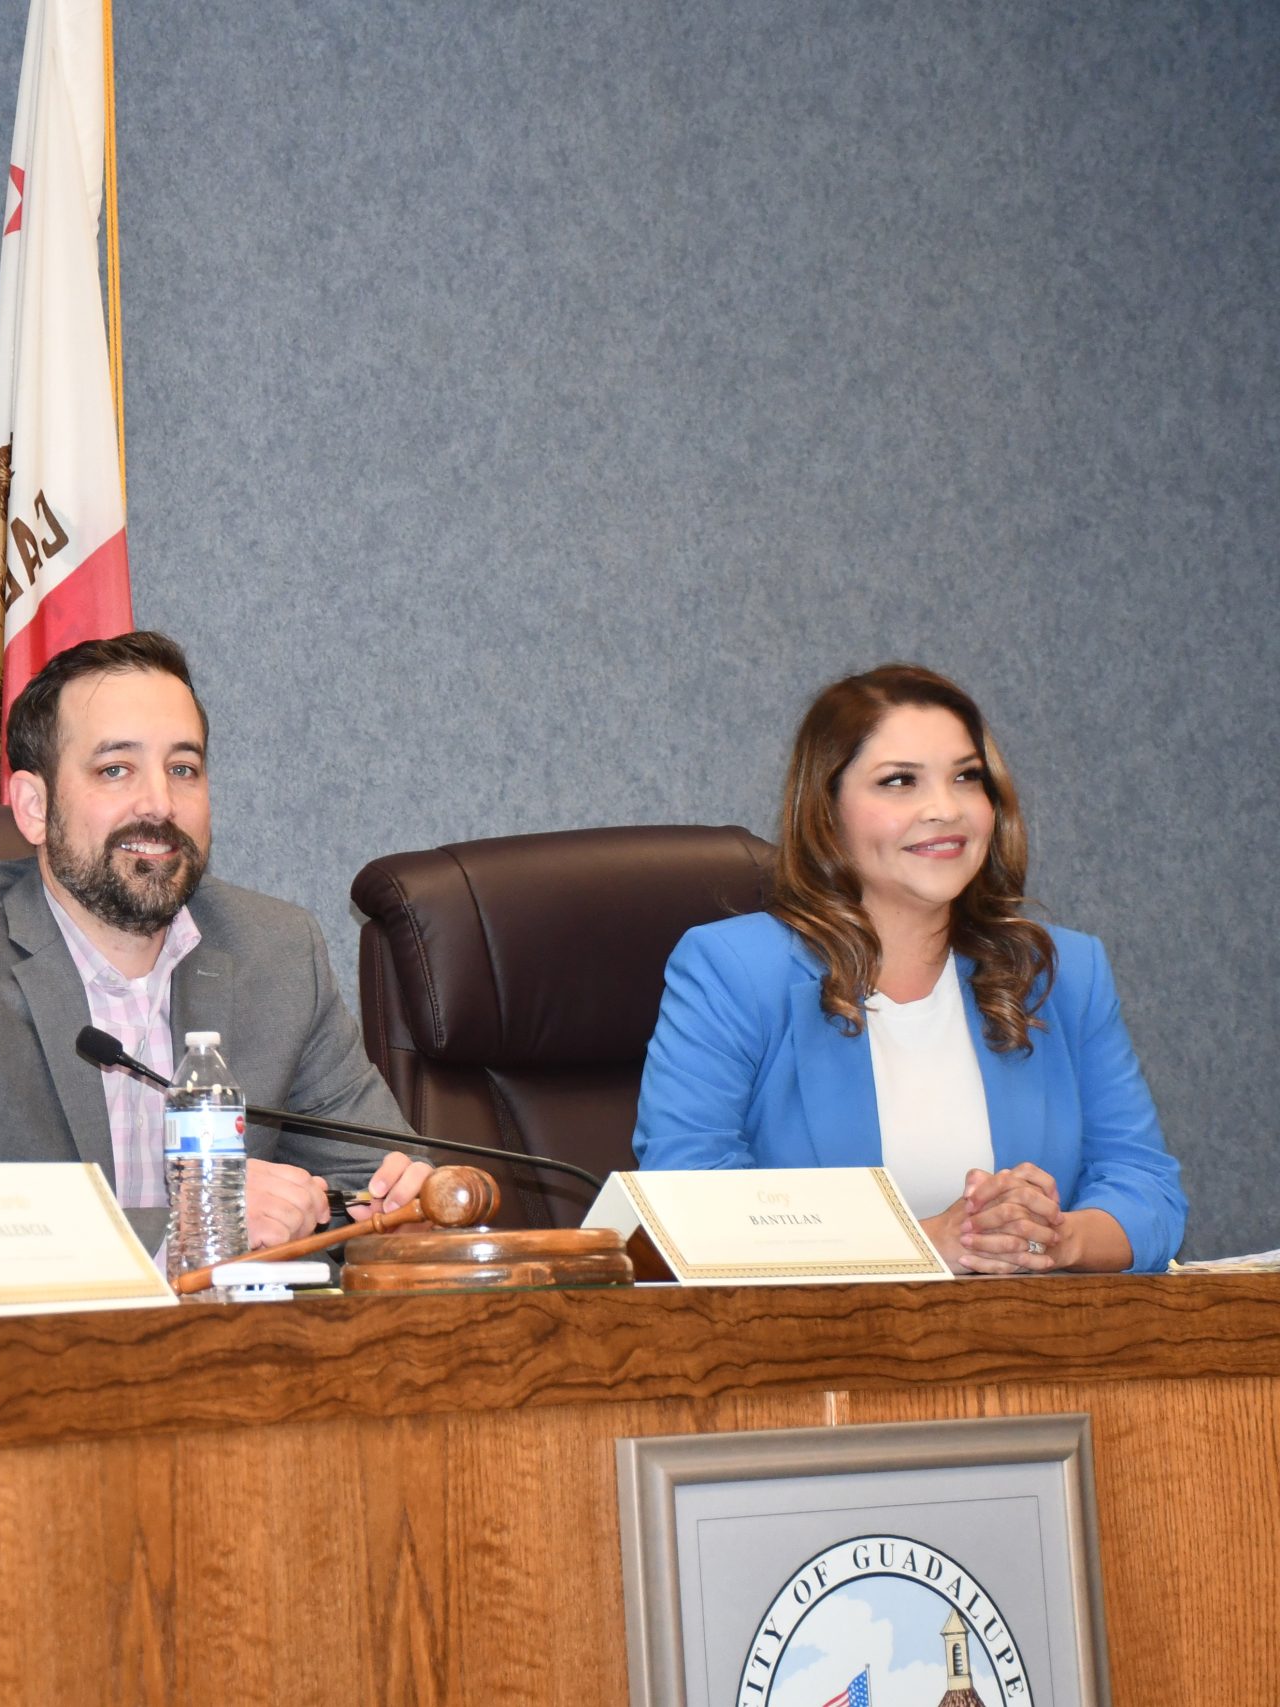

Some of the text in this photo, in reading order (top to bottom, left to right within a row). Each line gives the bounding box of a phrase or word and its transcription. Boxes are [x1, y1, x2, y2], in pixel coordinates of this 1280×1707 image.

[748, 1213, 823, 1226] BANTILAN
[742, 1542, 1028, 1707] ITY OF GUADALUPE
